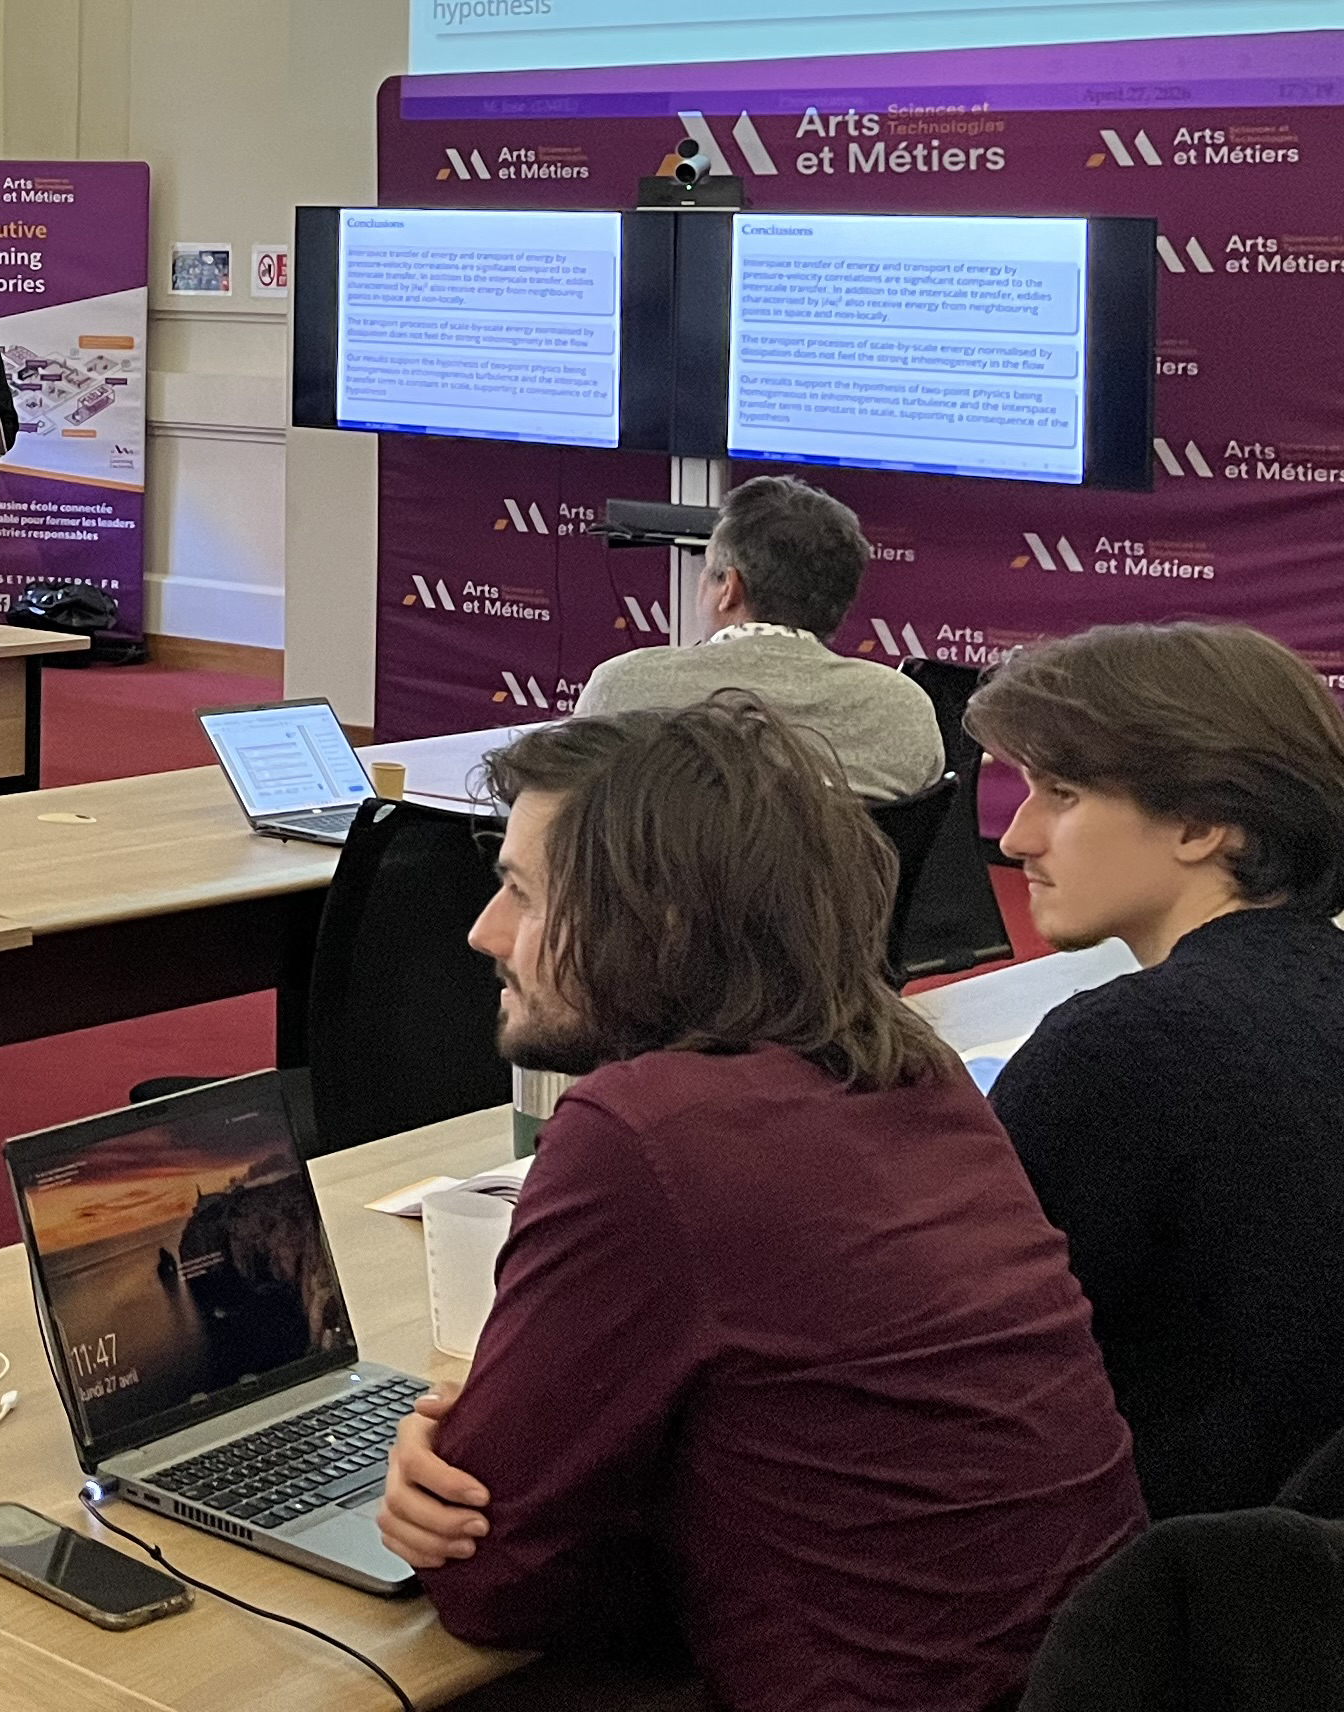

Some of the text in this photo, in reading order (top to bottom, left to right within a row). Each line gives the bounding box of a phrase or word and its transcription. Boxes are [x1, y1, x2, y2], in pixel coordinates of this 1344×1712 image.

[433, 0, 552, 25] hypothesis
[971, 102, 990, 113] et
[796, 107, 880, 138] Arts
[1173, 127, 1225, 146] Arts
[499, 147, 536, 163] Arts
[796, 139, 1005, 174] et Métiers
[1173, 145, 1299, 166] et Métiers
[499, 162, 589, 179] et Métiers
[3, 177, 33, 189] Arts
[3, 190, 74, 203] et Métiers
[347, 218, 405, 228] Conclusions
[742, 224, 813, 236] Conclusions
[1226, 234, 1278, 253] Arts
[846, 263, 880, 273] energy
[967, 266, 1002, 277] energy
[1225, 256, 1250, 273] et
[905, 302, 939, 312] energy
[940, 345, 975, 356] energy
[1156, 357, 1198, 376] iers
[1224, 440, 1275, 459] Arts
[1224, 462, 1248, 479] et
[0, 500, 113, 514] usine école connectée
[559, 503, 595, 520] Arts
[20, 517, 45, 526] pour
[45, 515, 81, 527] former
[82, 517, 96, 527] les
[98, 517, 135, 529] leaders
[557, 522, 575, 536] et
[27, 529, 99, 541] responsables
[868, 542, 915, 562] tiers
[1095, 536, 1144, 555] Arts
[1094, 556, 1215, 580] et Métiers
[463, 581, 499, 598] Arts
[462, 600, 551, 621] et Métiers
[936, 624, 983, 644] Arts
[936, 645, 958, 661] et
[555, 678, 584, 695] Art
[556, 698, 574, 713] et
[71, 1333, 117, 1377] 11:47
[104, 1375, 117, 1394] 27
[118, 1366, 140, 1388] avril
